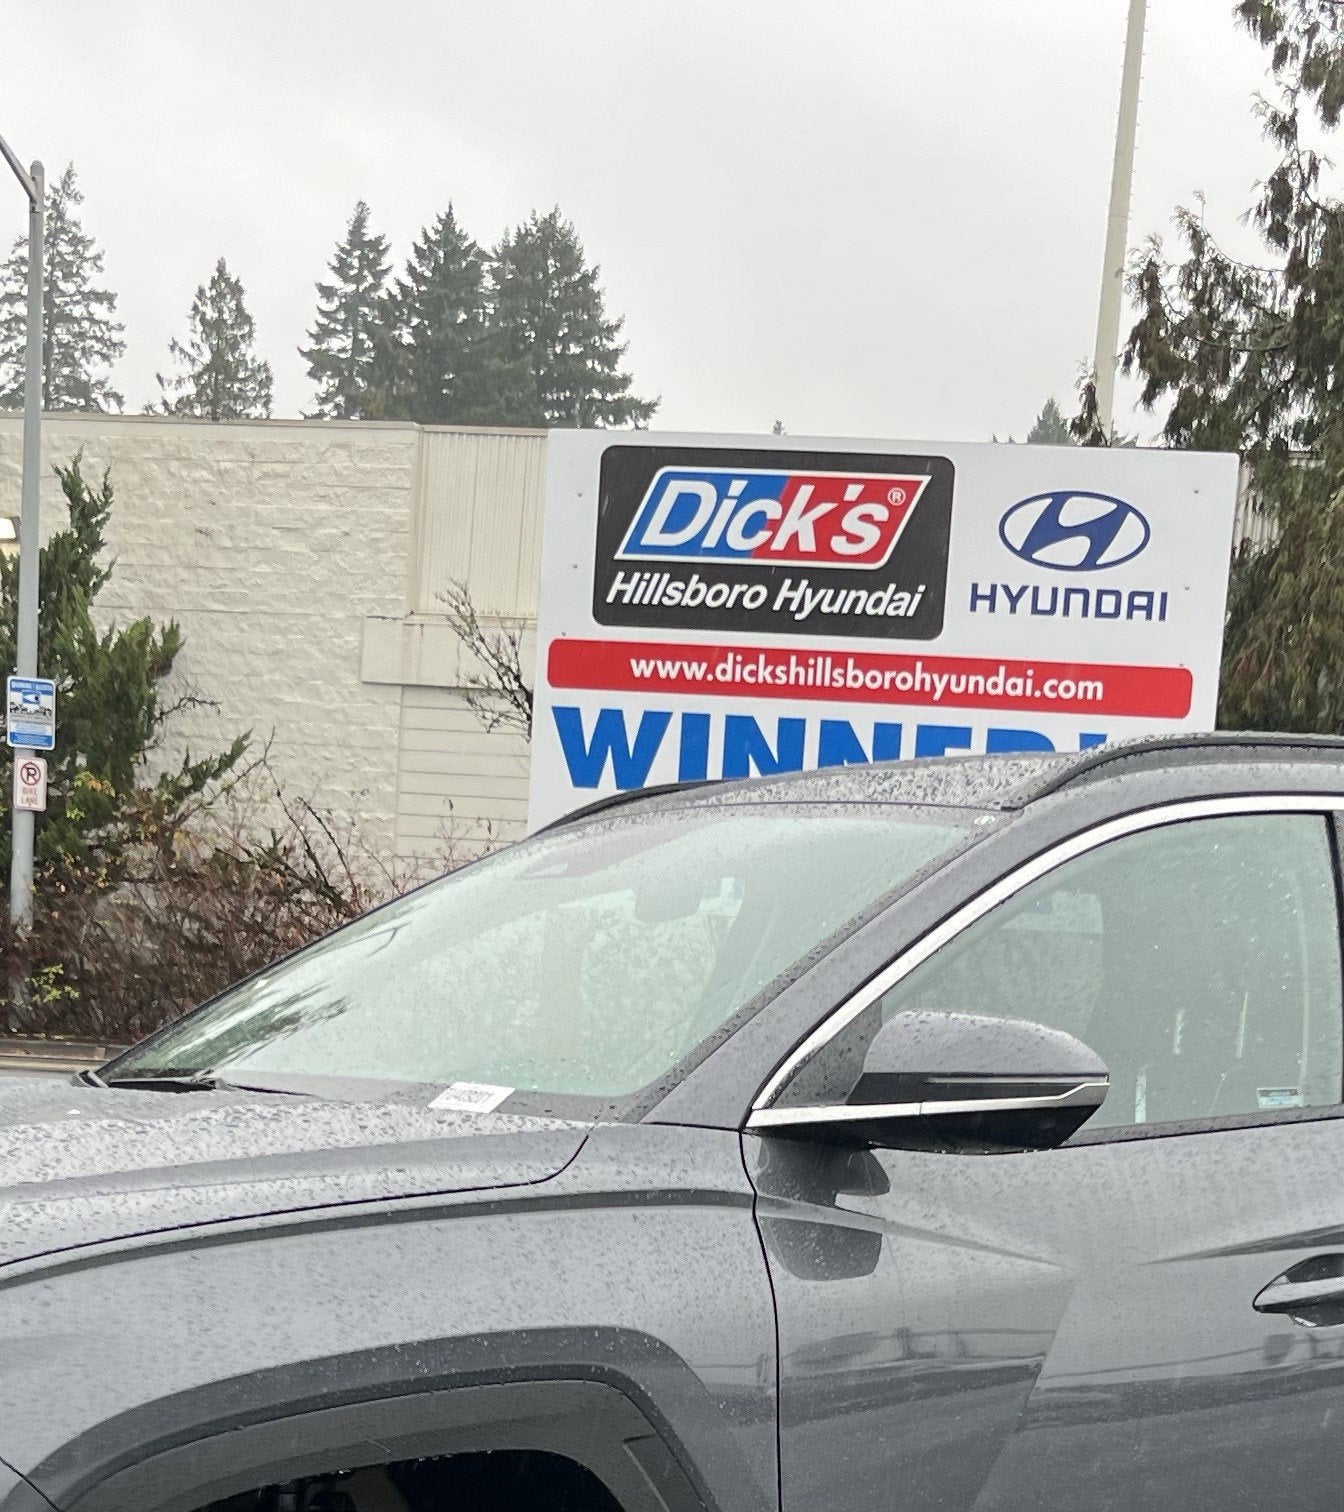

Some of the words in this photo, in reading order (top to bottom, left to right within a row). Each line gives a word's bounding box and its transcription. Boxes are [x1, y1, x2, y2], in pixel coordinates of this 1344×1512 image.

[606, 571, 768, 610] Hillsboro
[772, 578, 926, 622] Hyundai
[968, 582, 1168, 622] HYUNDAI
[629, 653, 1105, 702] www.dickshillsborohyundai.com
